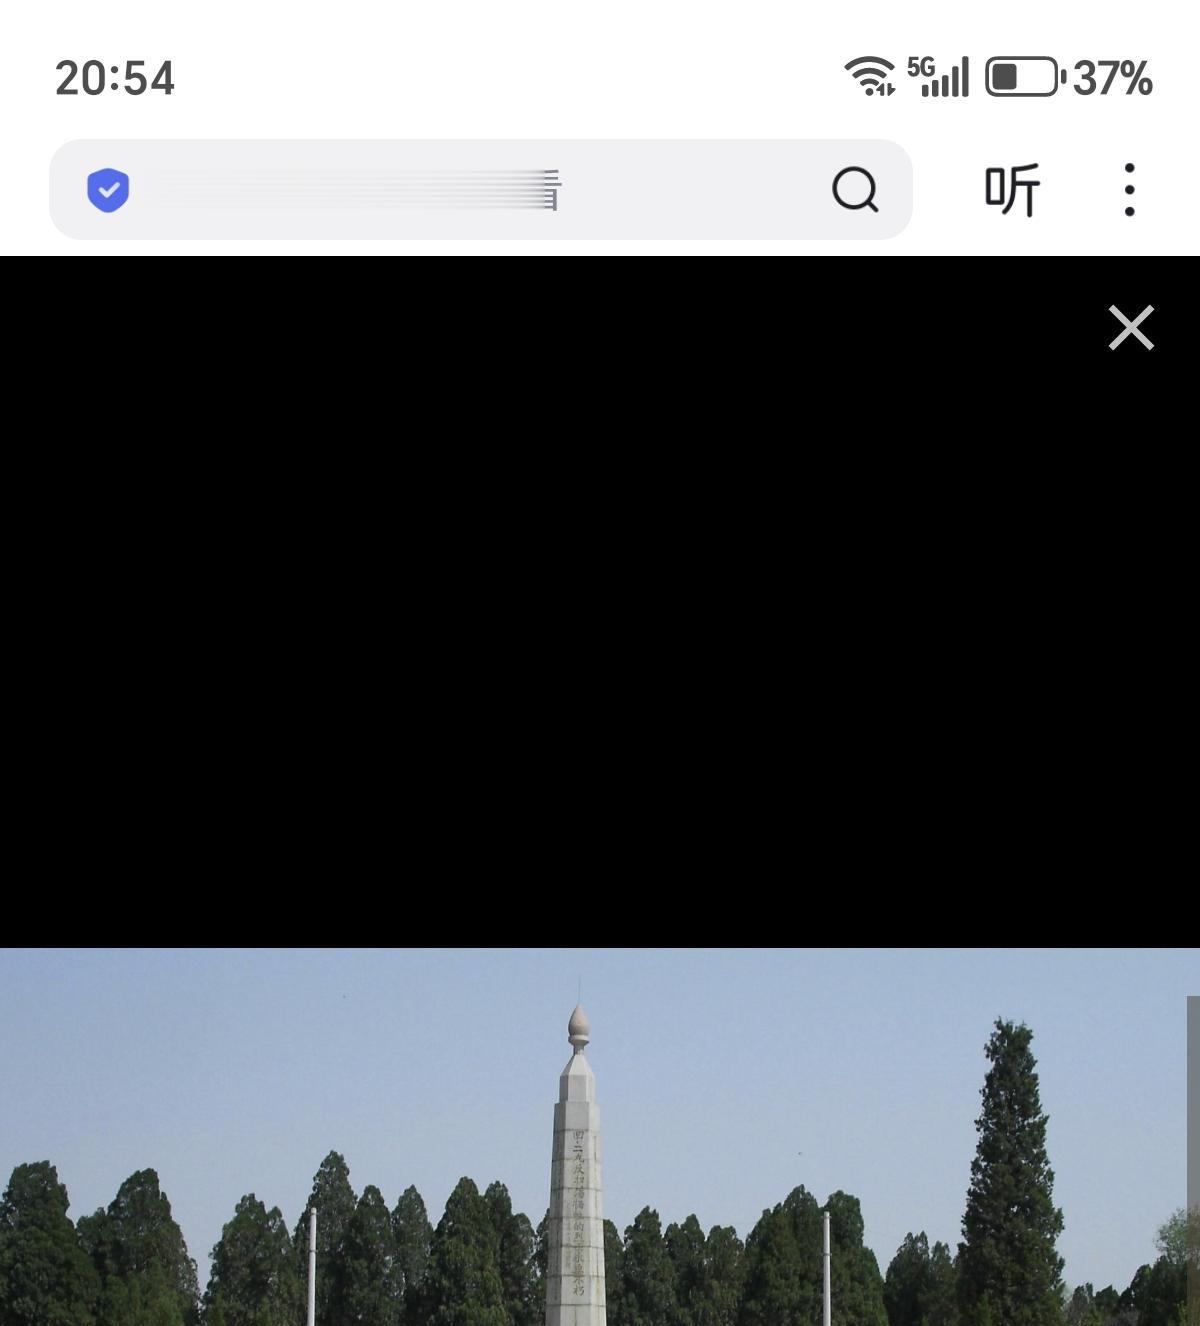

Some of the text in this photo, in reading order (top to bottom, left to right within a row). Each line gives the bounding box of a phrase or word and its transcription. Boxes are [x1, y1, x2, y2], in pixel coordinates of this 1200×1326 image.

[55, 59, 176, 97] 20:54
[906, 56, 936, 78] 5G
[1073, 59, 1154, 96] 37%
[984, 162, 1042, 219] 听
